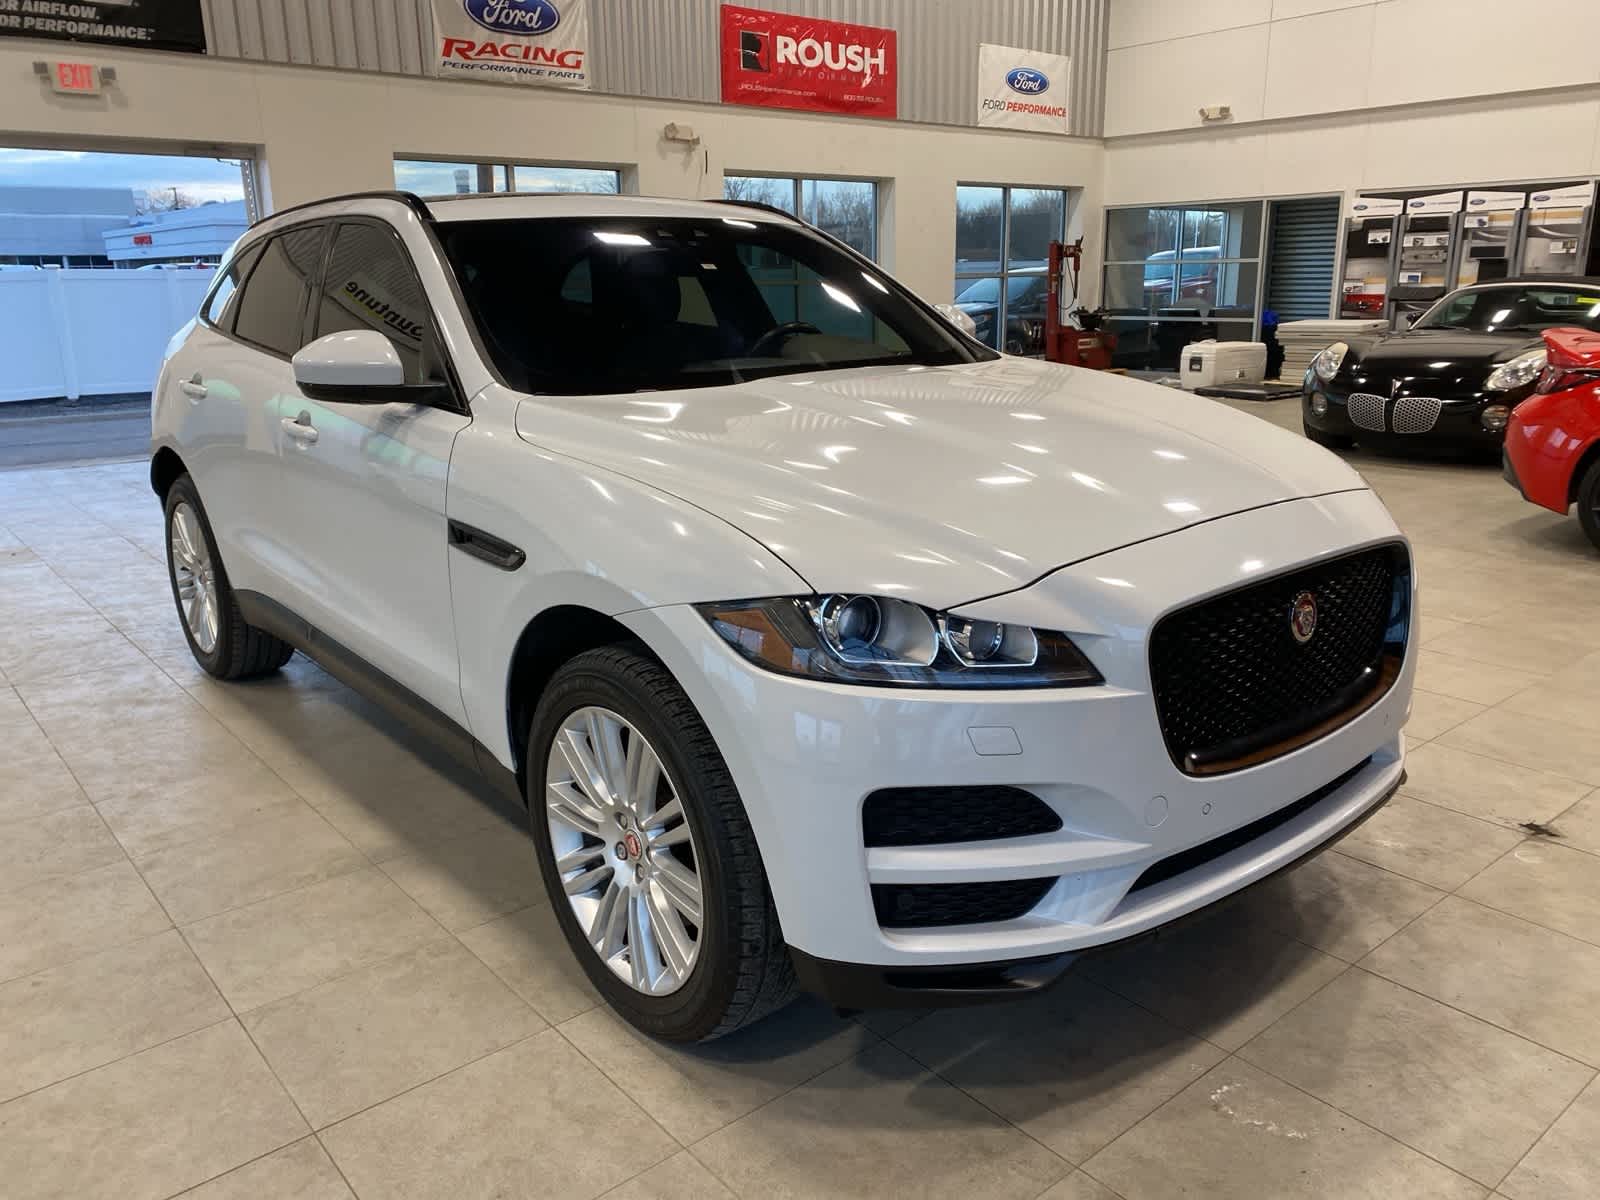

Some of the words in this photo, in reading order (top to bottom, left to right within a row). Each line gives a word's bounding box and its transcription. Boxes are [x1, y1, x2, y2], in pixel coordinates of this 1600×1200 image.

[21, 0, 100, 20] AIRFLOW.
[483, 0, 542, 28] Ford
[441, 37, 584, 70] RACING
[776, 35, 886, 75] ROUSH
[56, 63, 94, 90] EXIT
[442, 60, 545, 77] PERFORMANCE
[548, 70, 585, 80] PARTS
[1013, 71, 1041, 91] Ford
[982, 98, 1006, 111] FORD
[1006, 101, 1067, 118] PERFORMANCE
